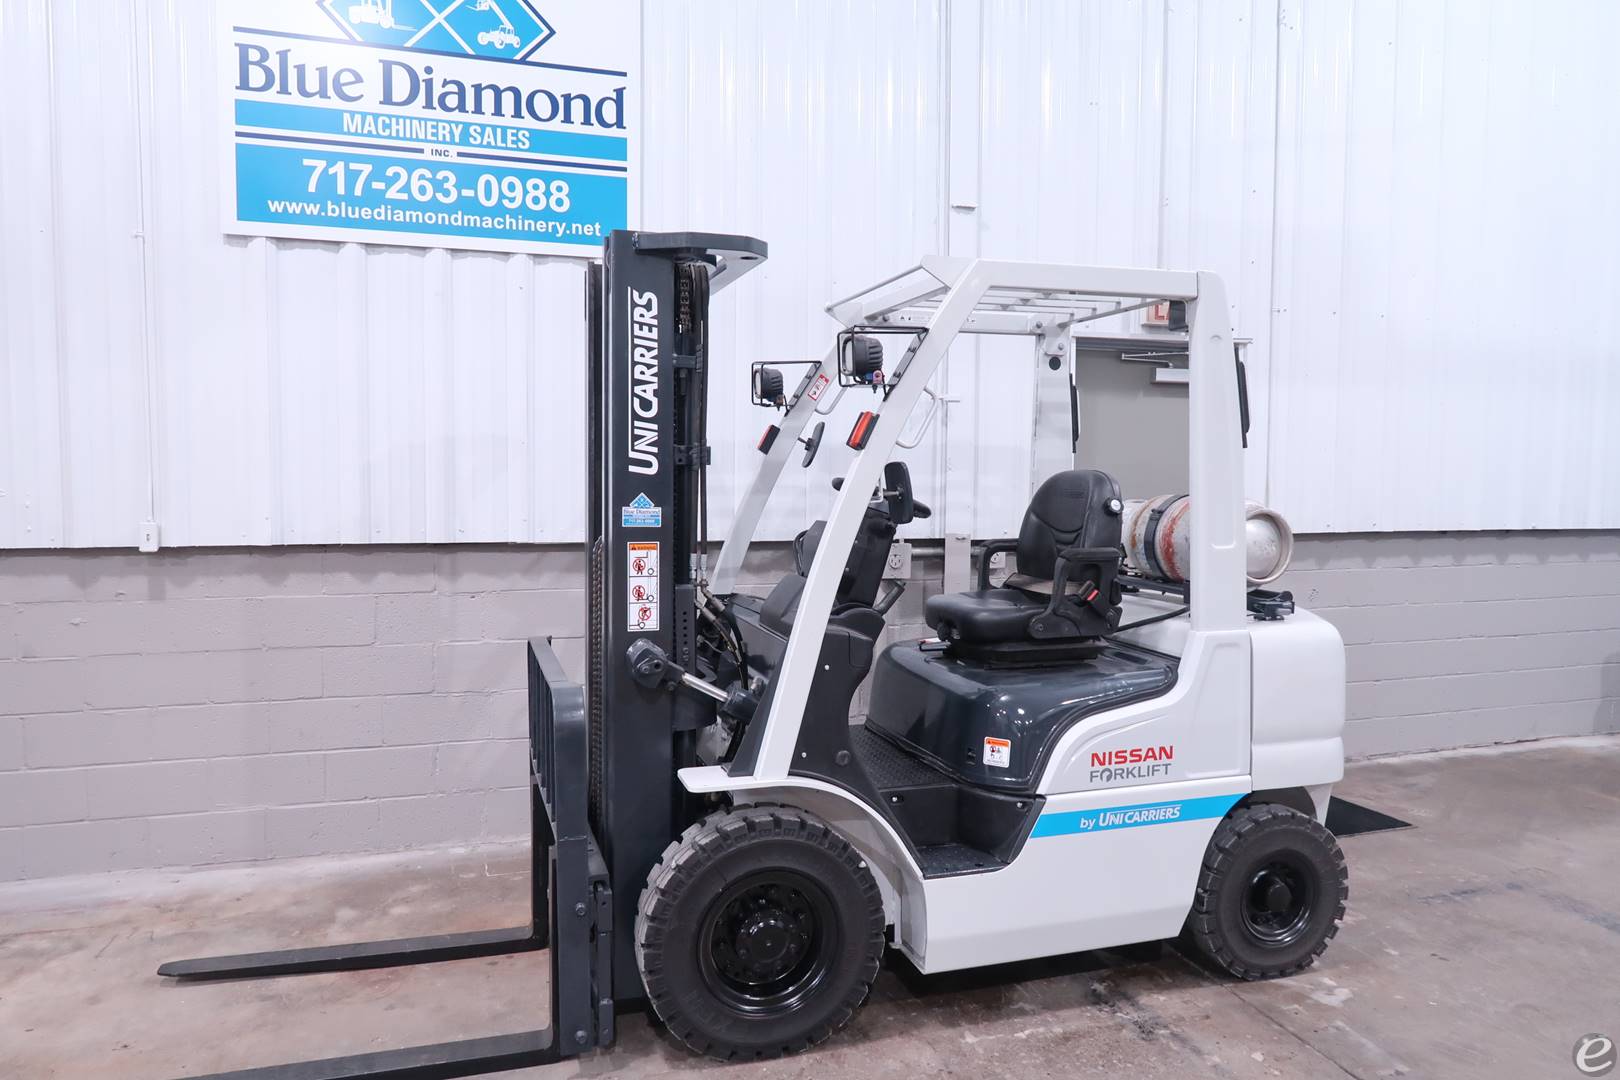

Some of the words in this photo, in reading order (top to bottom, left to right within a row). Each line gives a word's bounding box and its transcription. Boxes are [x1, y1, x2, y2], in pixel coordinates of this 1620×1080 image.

[234, 42, 364, 102] Blue
[378, 58, 627, 130] Diamond
[343, 112, 463, 143] MACHINERY
[469, 125, 530, 149] SALES
[431, 148, 453, 158] INC.
[302, 158, 571, 213] 717-263-0988
[268, 199, 601, 237] www.bluediamondmachinery.net
[1091, 745, 1173, 767] NISSAN
[1090, 763, 1172, 783] FORKLIFT
[1080, 817, 1096, 829] by
